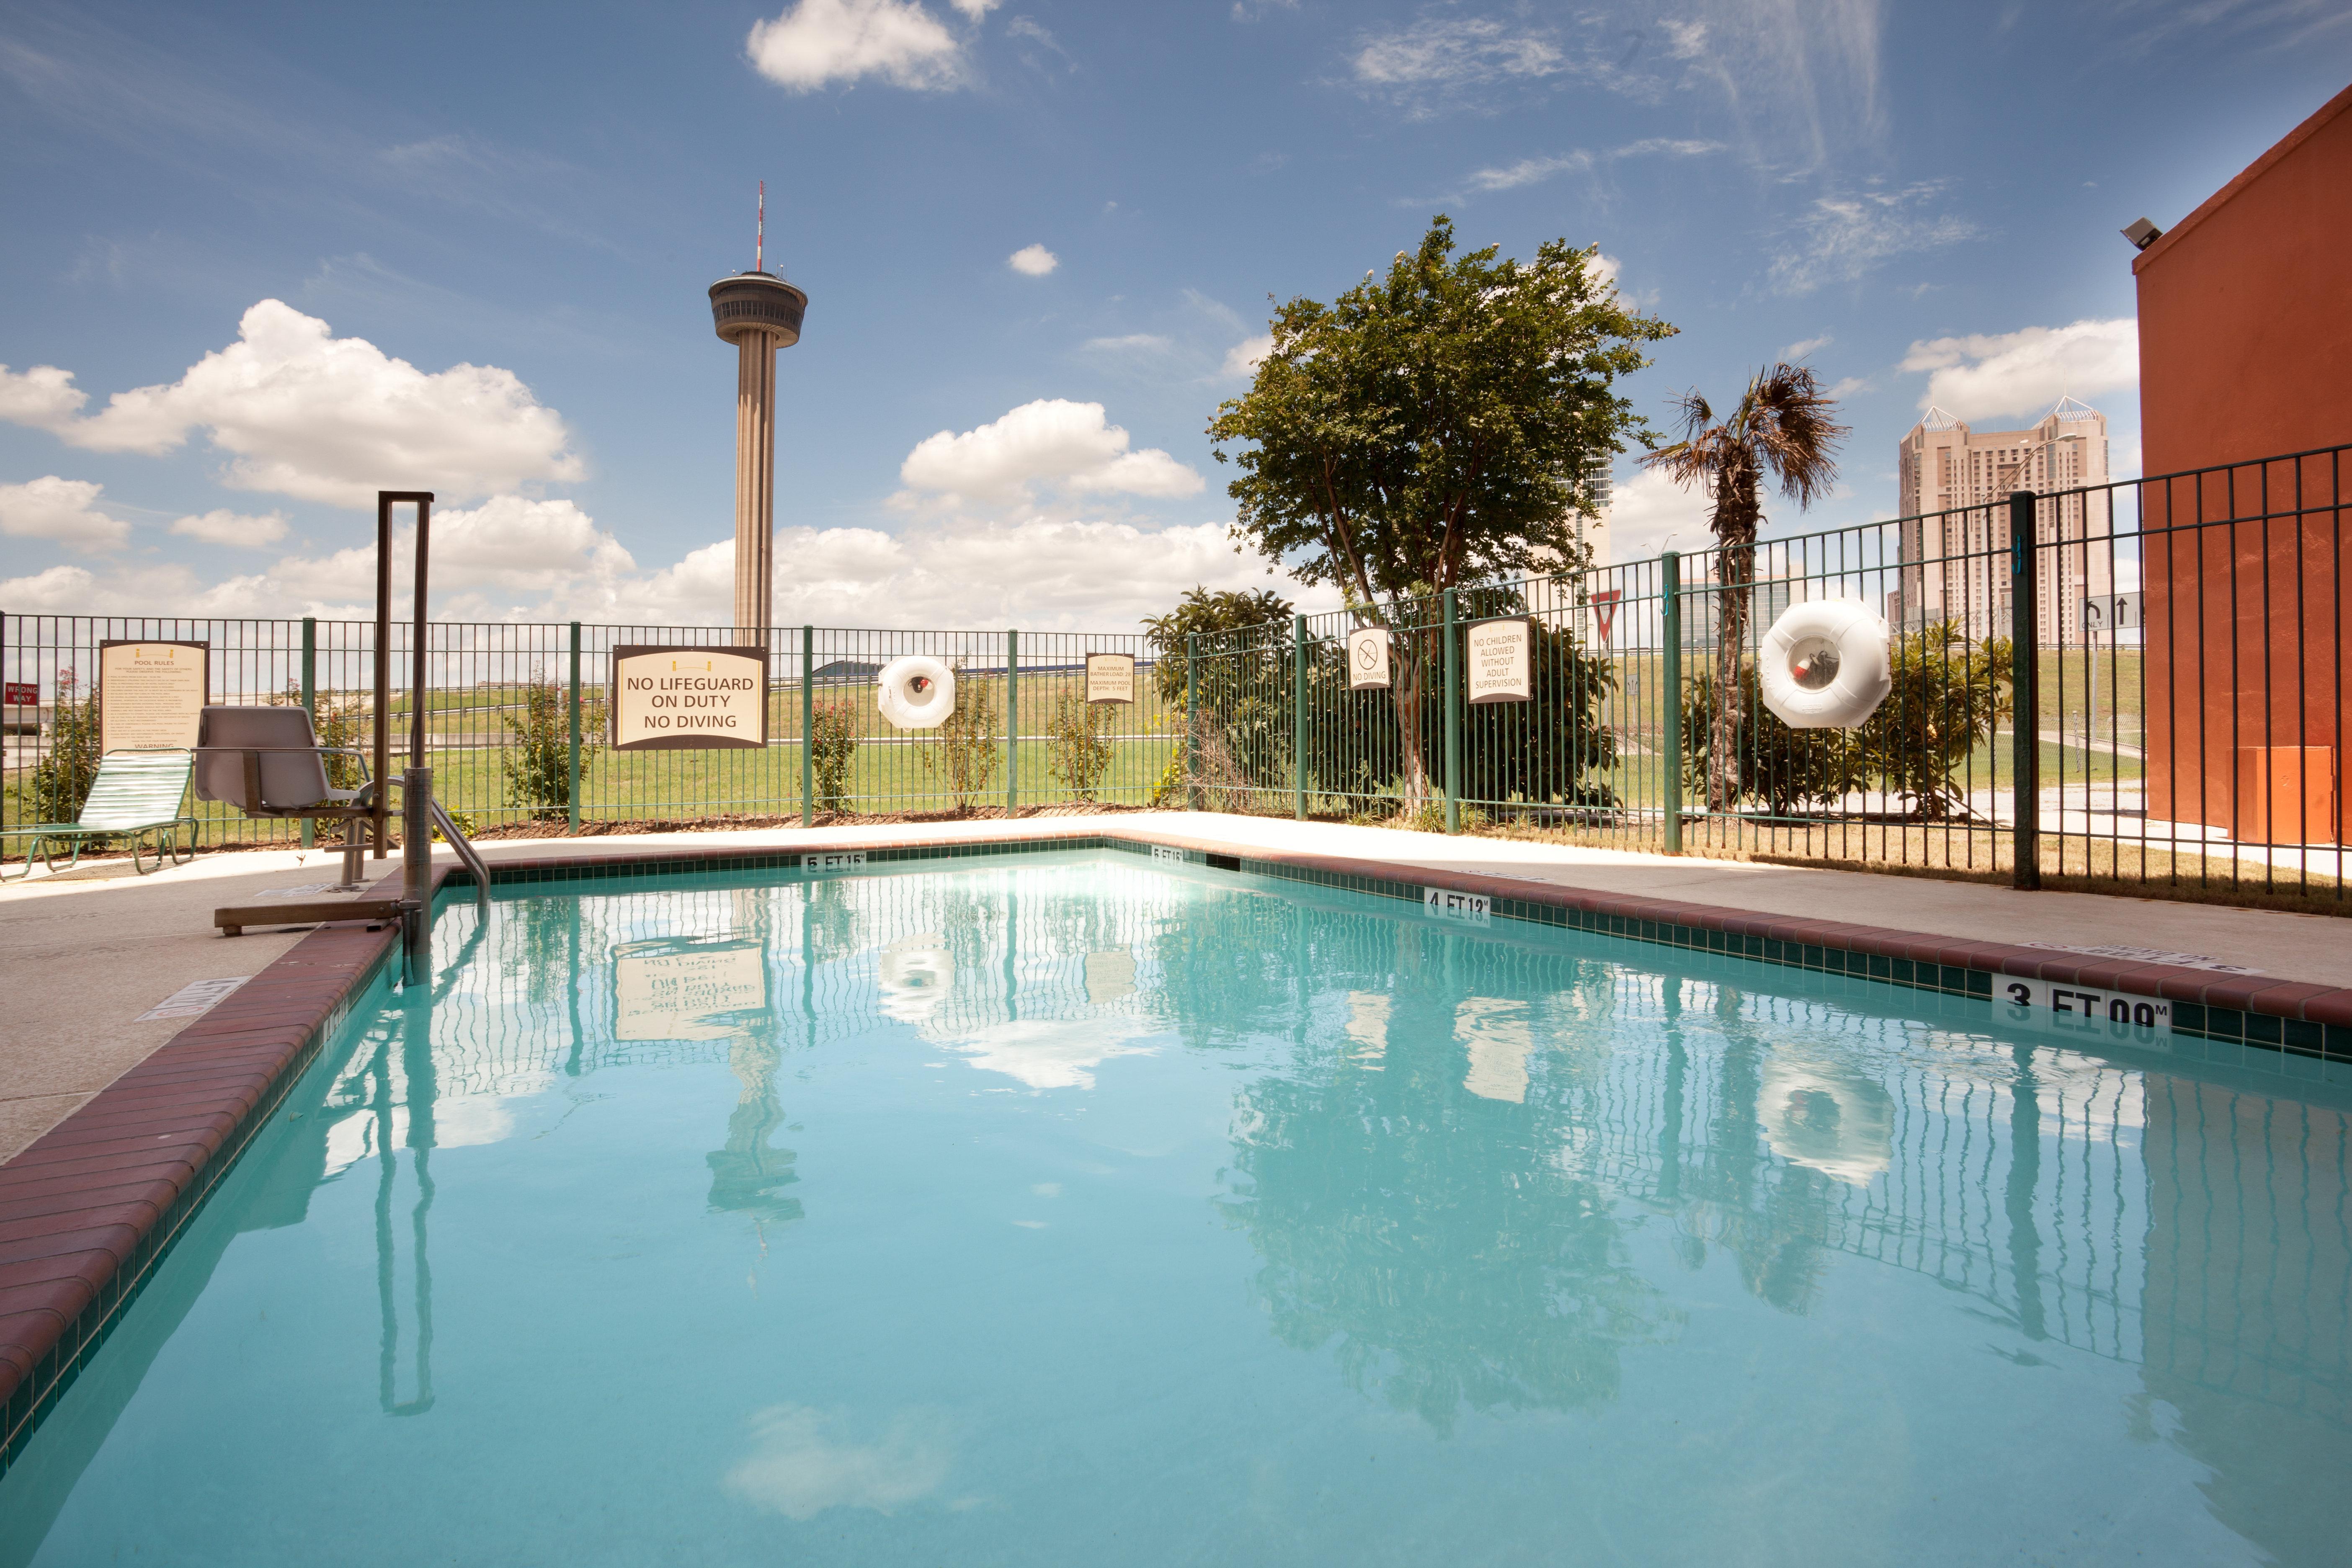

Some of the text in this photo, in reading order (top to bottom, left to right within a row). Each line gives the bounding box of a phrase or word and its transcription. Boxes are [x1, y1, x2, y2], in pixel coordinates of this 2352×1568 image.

[1474, 634, 1522, 647] NO CHILDREN
[1480, 646, 1514, 657] ALLOWED
[1481, 657, 1514, 667] WITHOUT
[1364, 671, 1386, 679] DIVING
[1486, 668, 1508, 677] ADULT
[627, 678, 753, 690] NO LIFEGUARD
[1476, 678, 1521, 689] SUPERVISION
[652, 695, 731, 707] ON DUTY
[645, 715, 736, 728] NO DIVING
[1163, 850, 1171, 859] FT
[807, 857, 817, 866] 5
[825, 856, 843, 865] FT
[1447, 894, 1465, 909] FT
[2101, 944, 2174, 956] DIVING
[2133, 956, 2193, 965] FT
[2007, 983, 2031, 1006] 3
[2053, 989, 2100, 1018] FT
